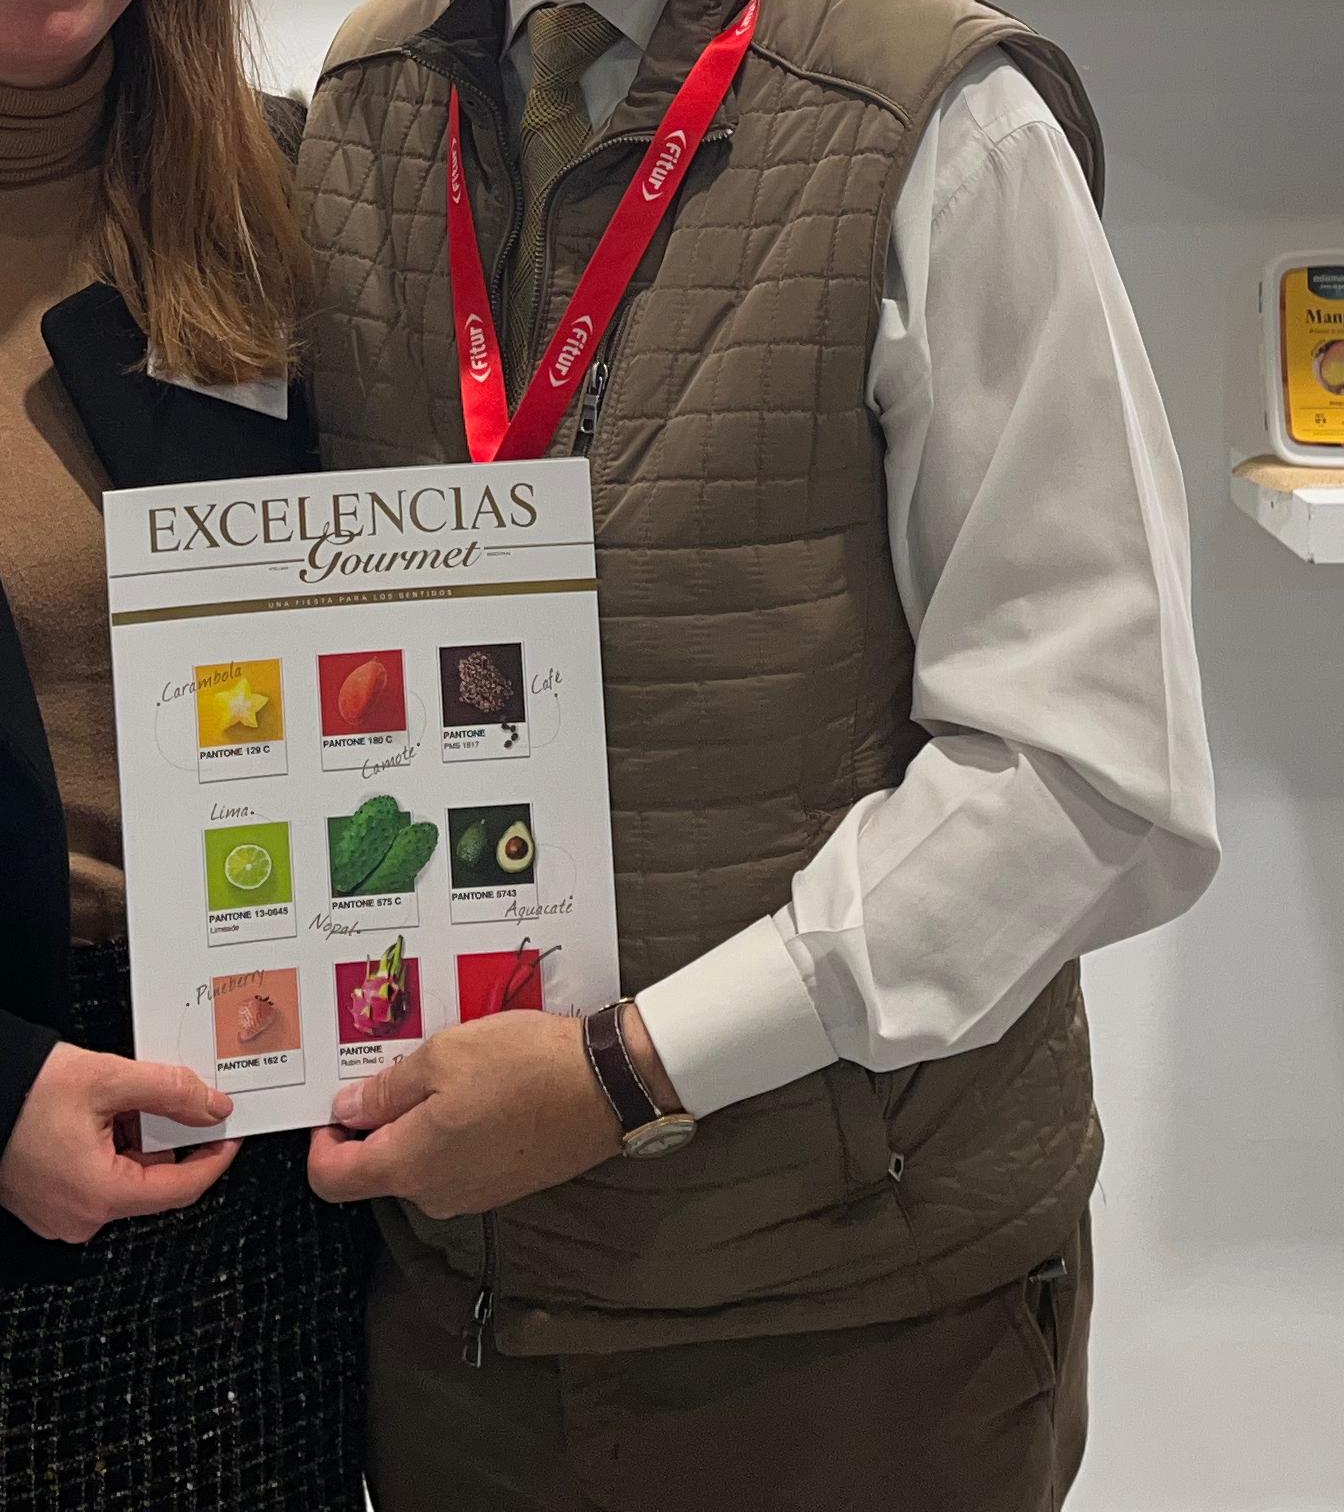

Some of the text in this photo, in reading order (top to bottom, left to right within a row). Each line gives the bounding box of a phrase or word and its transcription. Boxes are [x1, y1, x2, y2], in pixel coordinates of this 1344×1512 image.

[147, 481, 539, 554] EXCELENCIAS
[299, 522, 483, 584] Gourmet
[267, 588, 454, 610] UNA FIESTA PARA LOS SENTIDOS
[161, 660, 243, 703] Carambola
[323, 736, 367, 748] PANTONE
[385, 735, 393, 744] C
[443, 728, 486, 739] PANTONE
[199, 745, 271, 760] PANTONE 129 C
[361, 747, 416, 779] Camote
[332, 899, 374, 910] PANTONE
[394, 897, 402, 906] C
[452, 892, 494, 901] PANTONE
[209, 910, 252, 923] PANTONE
[196, 969, 265, 1005] Pineberry
[340, 1045, 382, 1056] PANTONE
[217, 1059, 260, 1072] PANTONE
[280, 1055, 288, 1064] C
